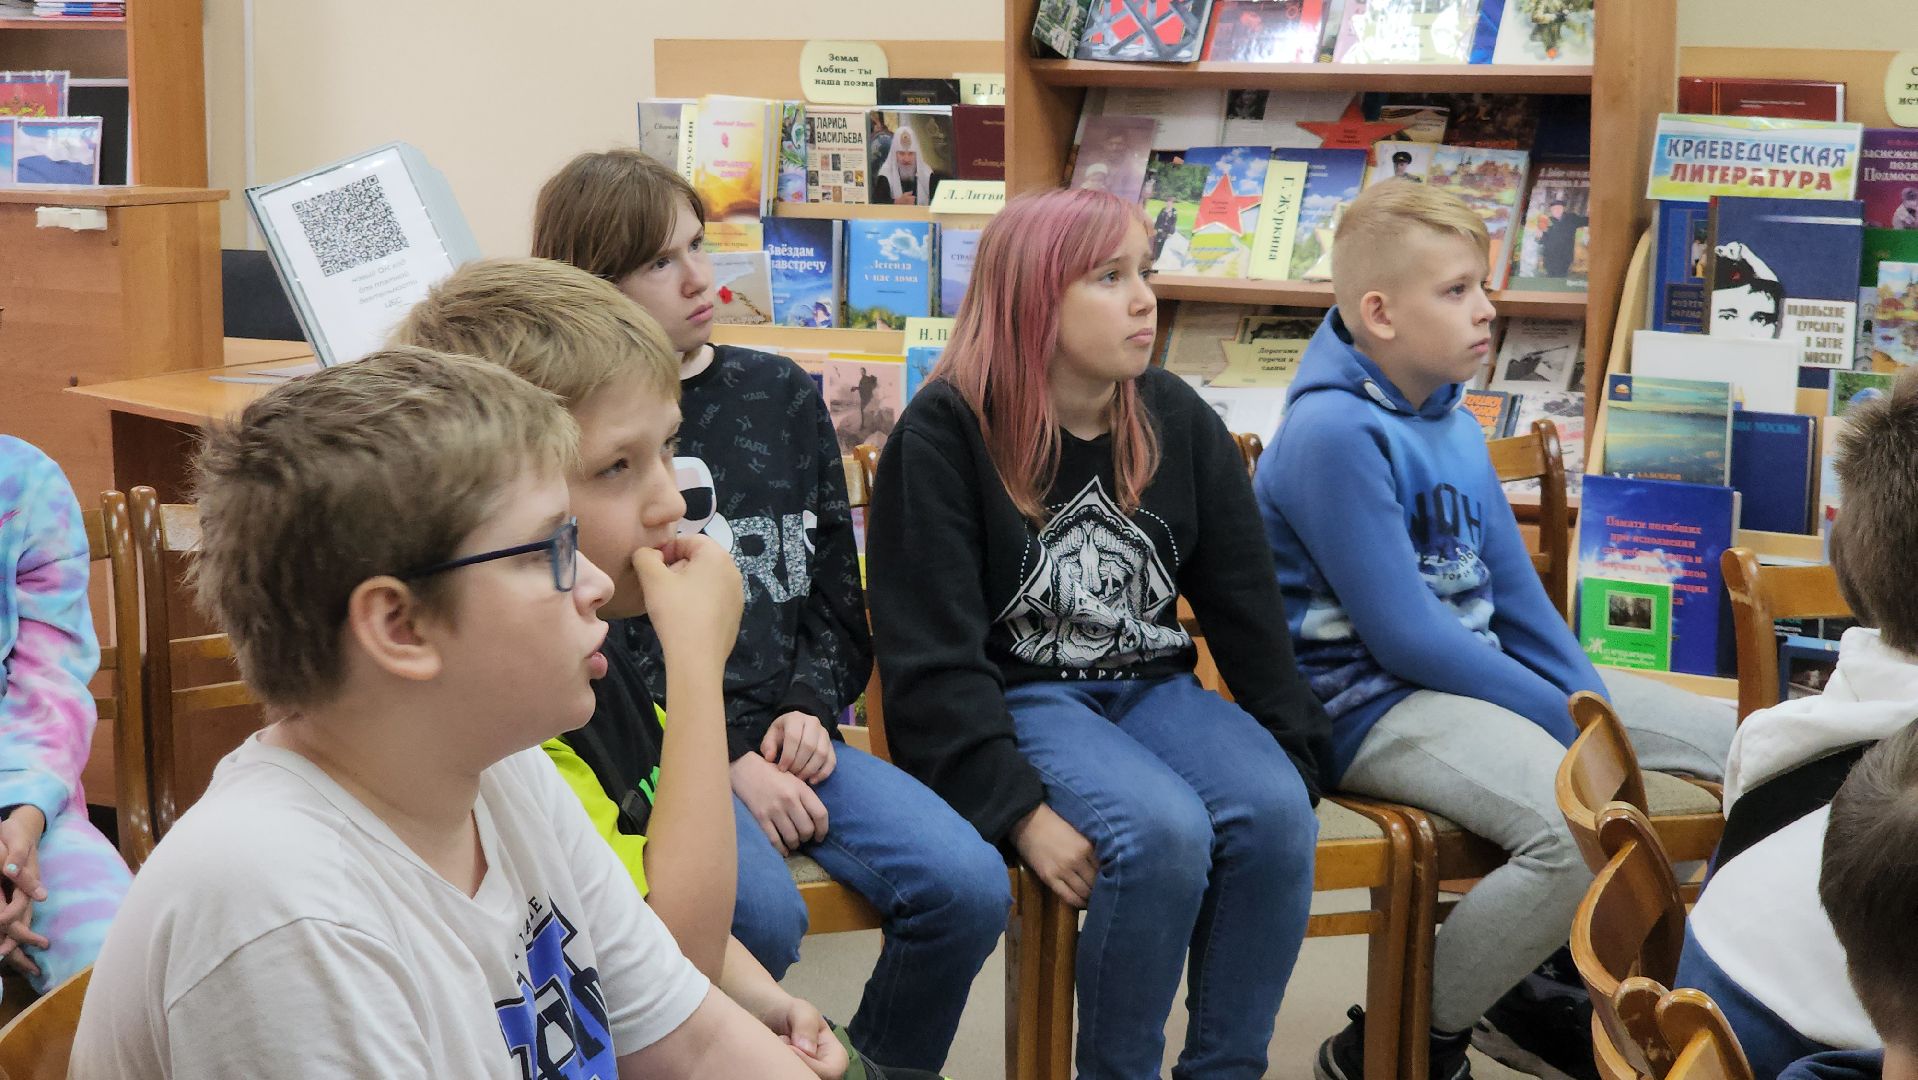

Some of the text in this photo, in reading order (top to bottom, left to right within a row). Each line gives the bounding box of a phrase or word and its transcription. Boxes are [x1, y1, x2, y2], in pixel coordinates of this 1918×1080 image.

[828, 53, 859, 62] Земля
[816, 65, 847, 74] Лобни
[843, 80, 874, 88] поэма
[816, 117, 847, 129] ЛАРИСА
[816, 131, 863, 144] ВАСИЛЬЕВА
[684, 121, 694, 181] апустин
[1667, 138, 1846, 168] КРАЕВЕДЧЕСКАЯ
[1670, 163, 1832, 191] ЛИТЕРАТУРА
[767, 243, 814, 258] Звёздам
[1797, 320, 1845, 333] КУРСАНТЫ
